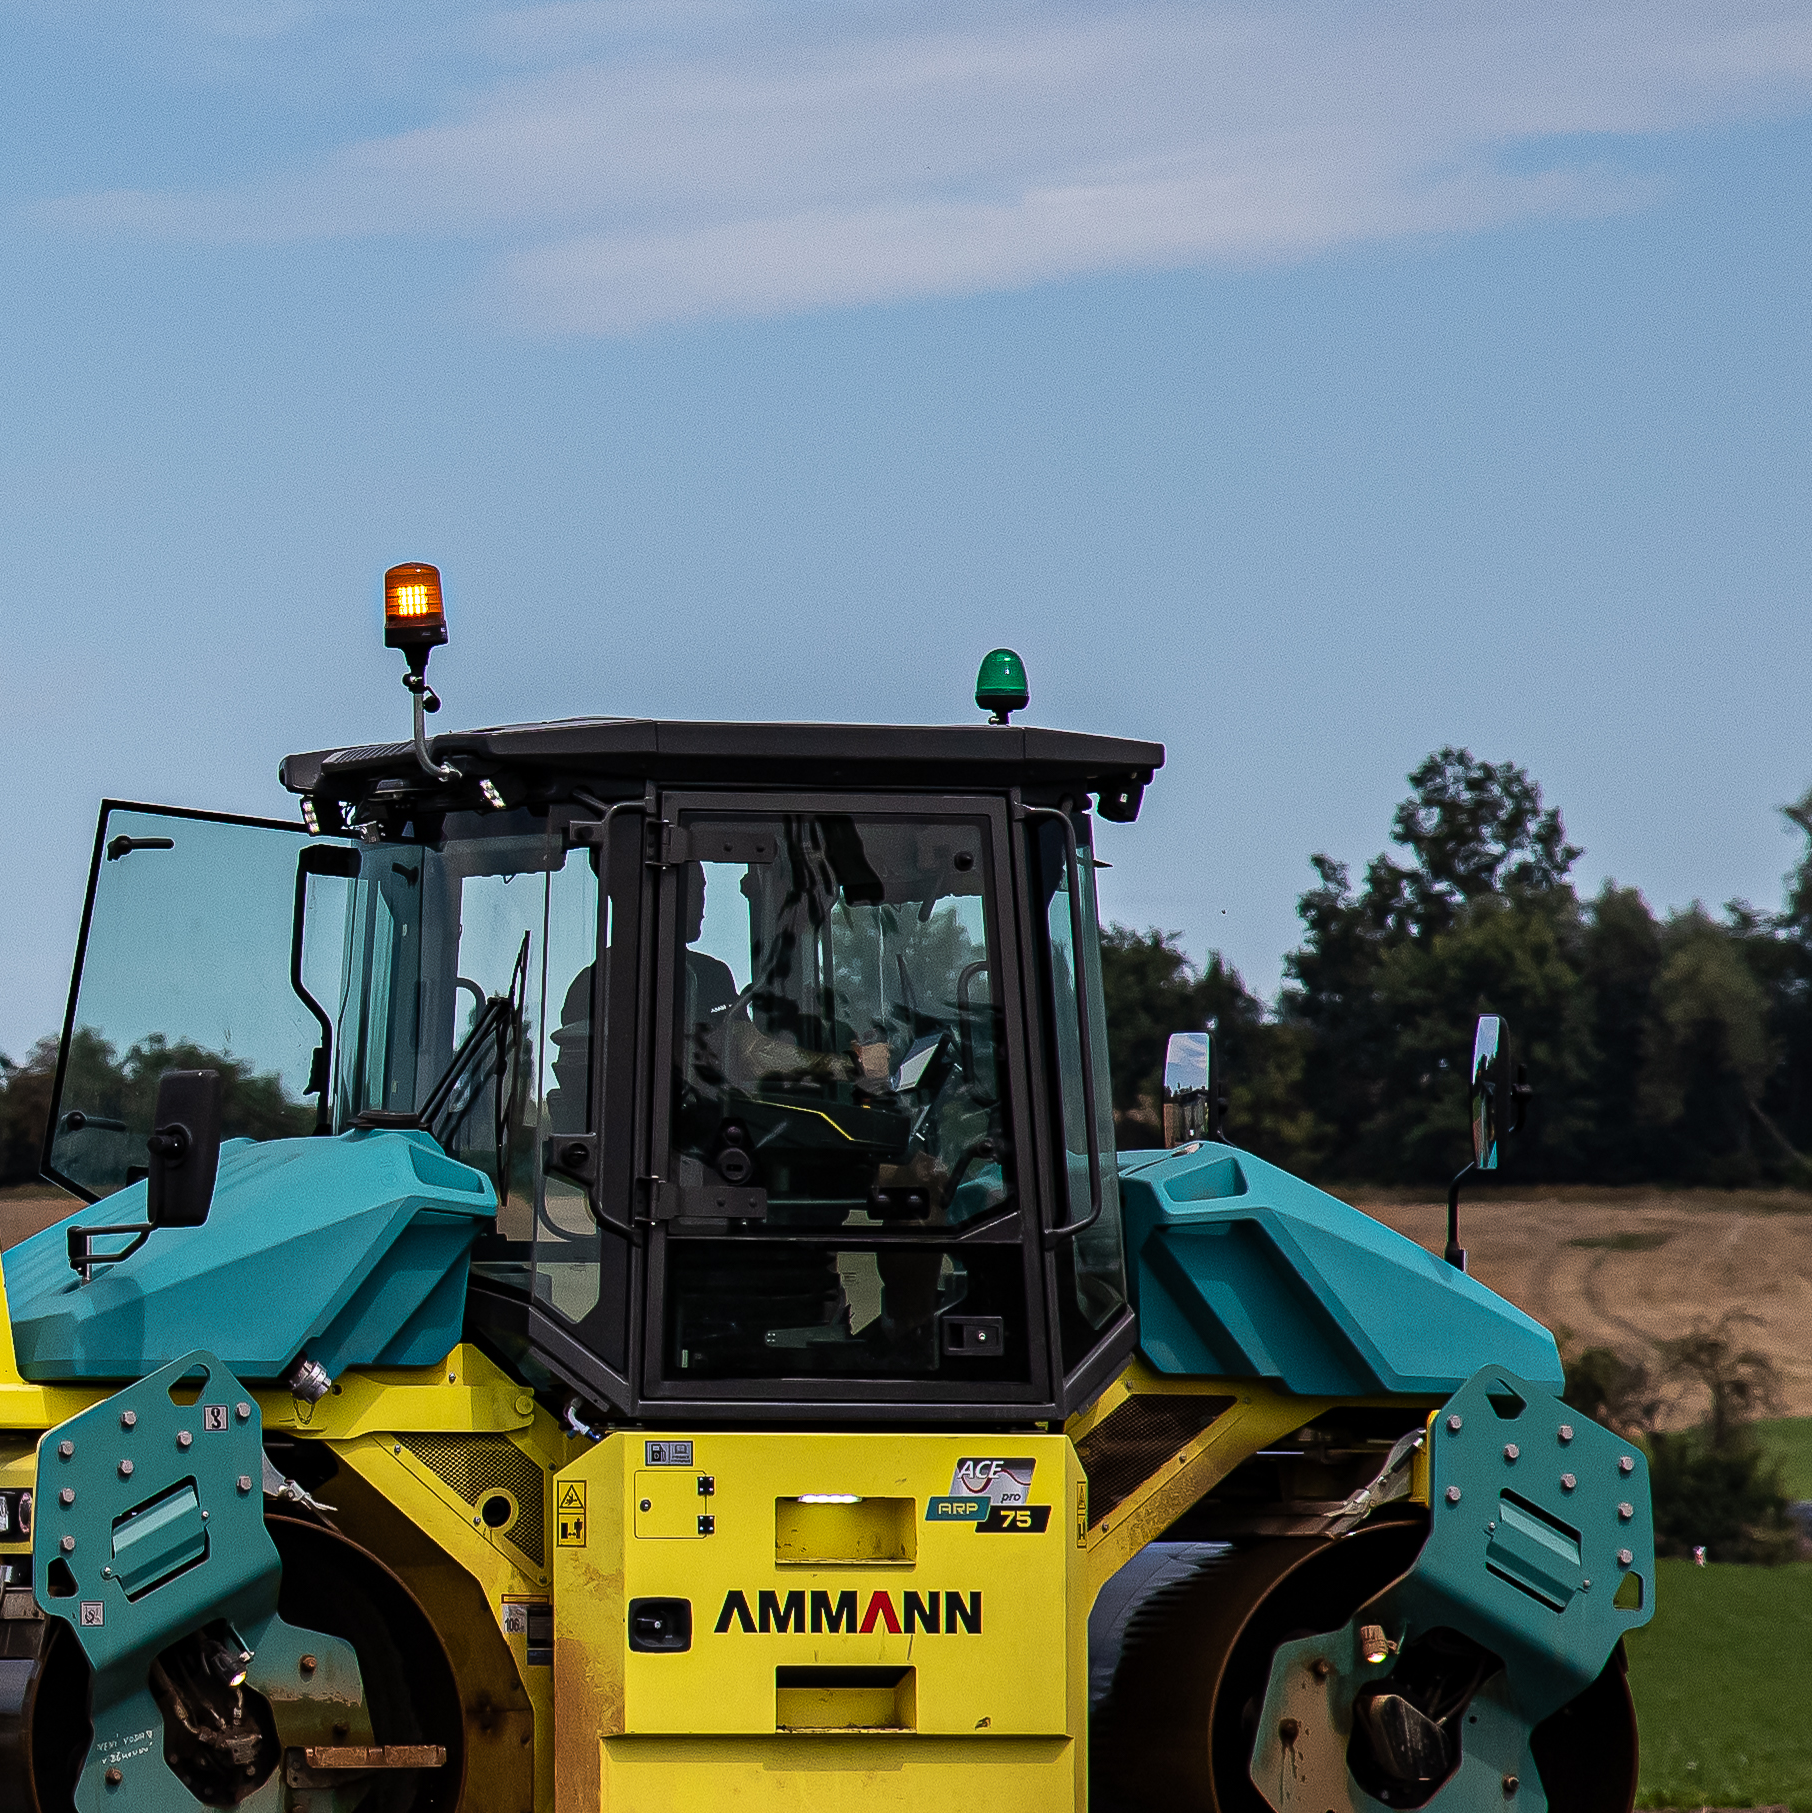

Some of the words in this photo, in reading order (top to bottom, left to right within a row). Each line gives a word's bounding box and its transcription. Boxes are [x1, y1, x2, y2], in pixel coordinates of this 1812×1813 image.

[957, 1460, 1004, 1479] ACE
[1000, 1492, 1021, 1504] pro
[938, 1503, 979, 1515] ARP
[1000, 1510, 1032, 1528] 75
[713, 1589, 983, 1635] AMMANN
